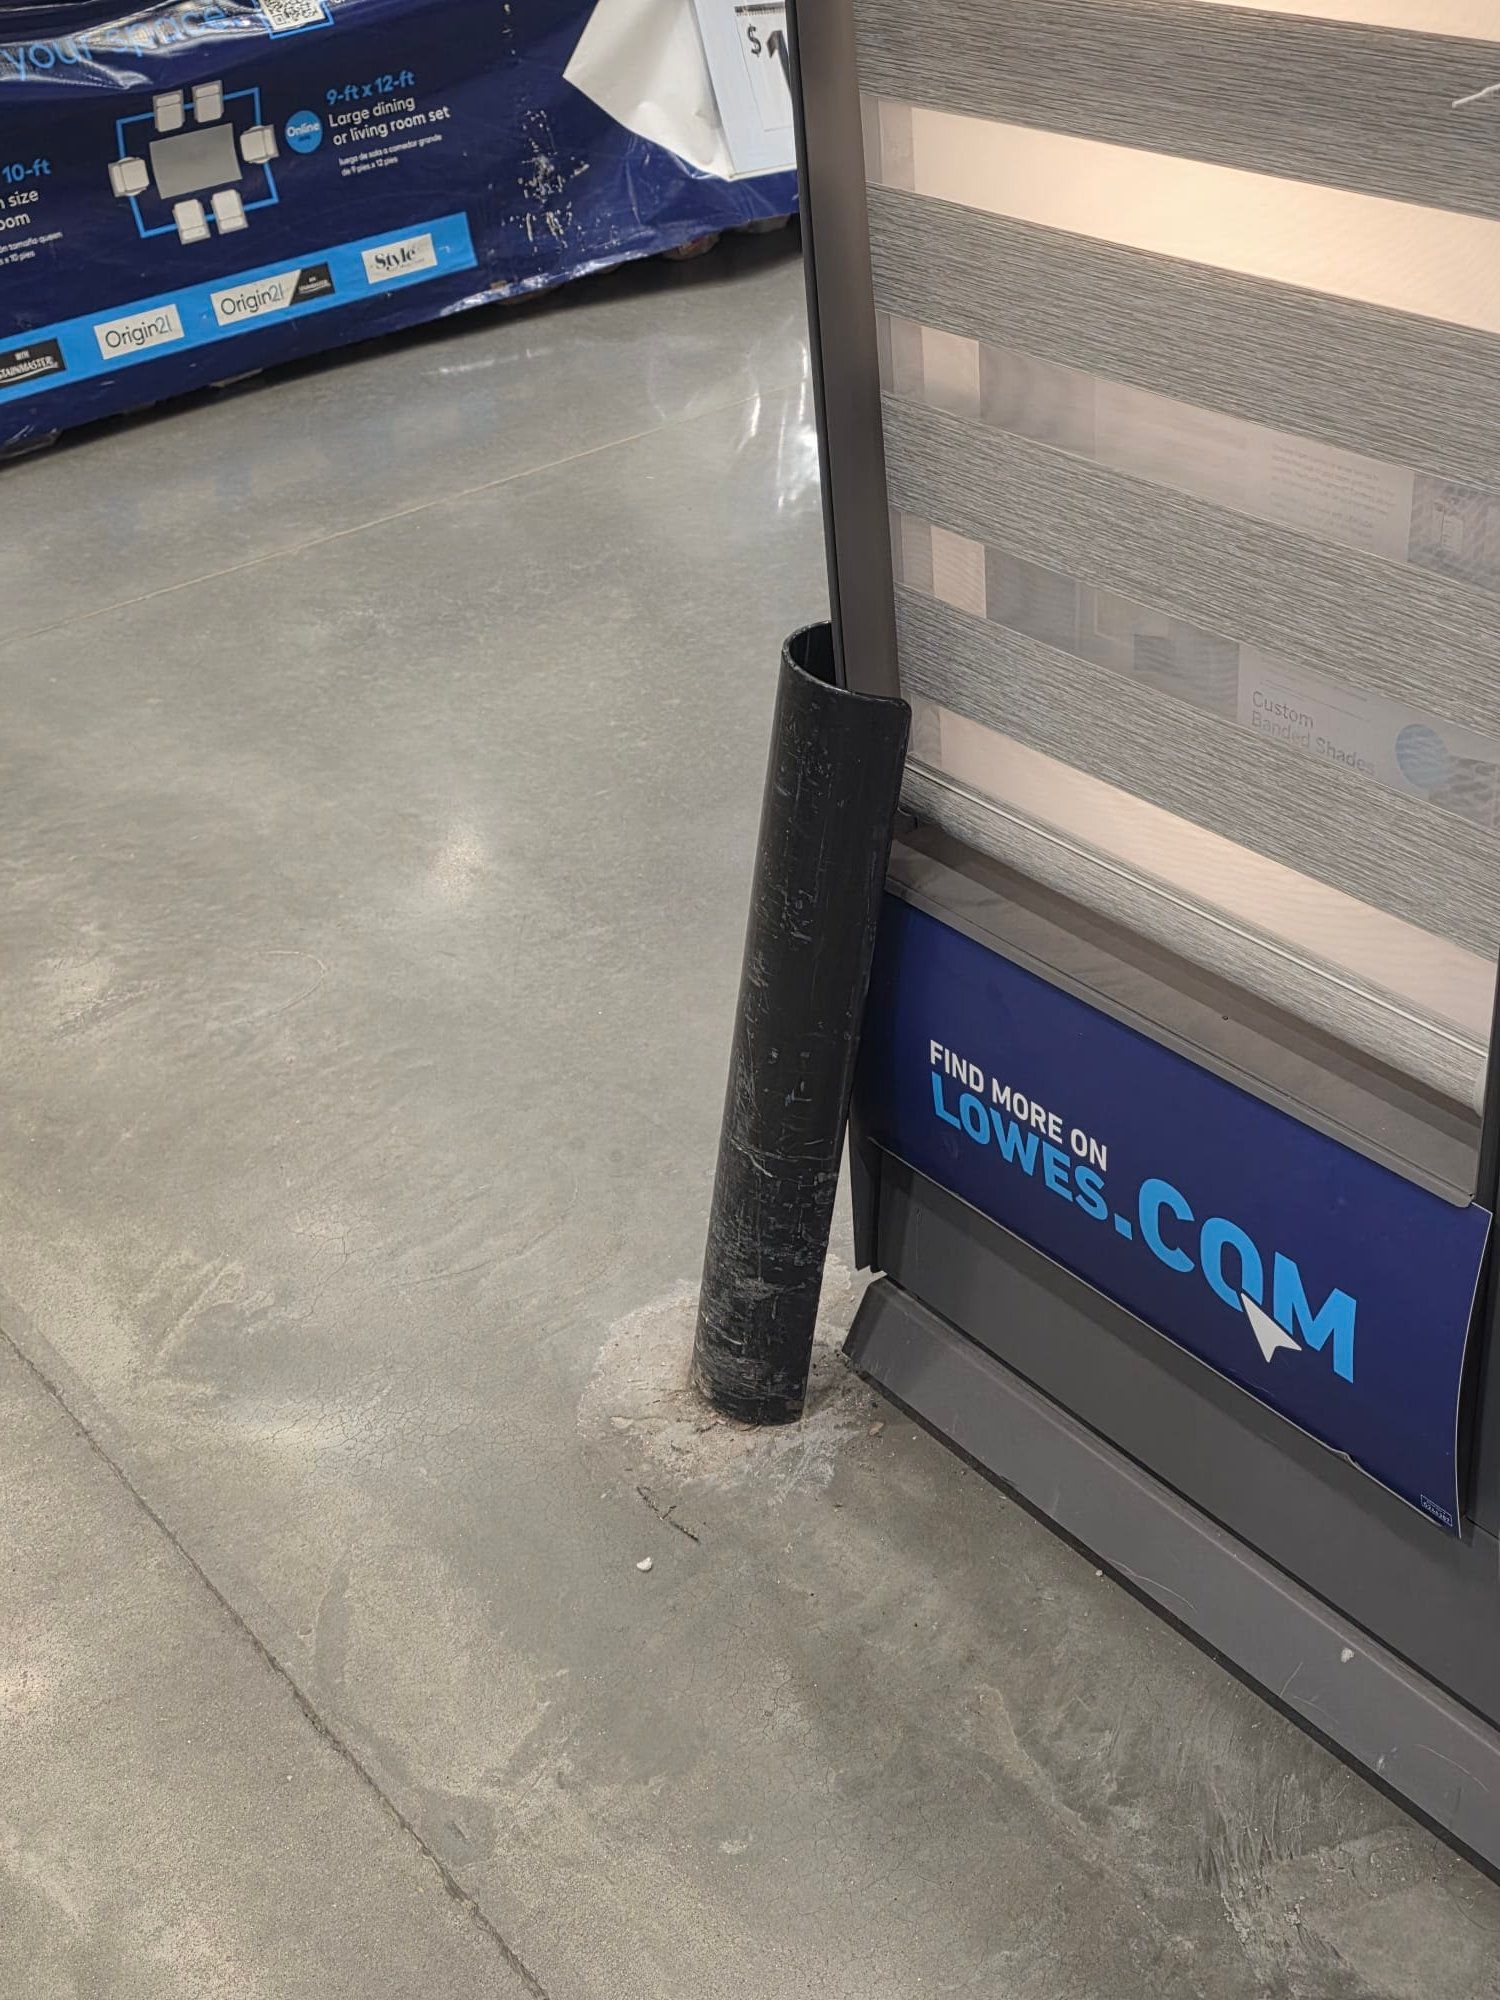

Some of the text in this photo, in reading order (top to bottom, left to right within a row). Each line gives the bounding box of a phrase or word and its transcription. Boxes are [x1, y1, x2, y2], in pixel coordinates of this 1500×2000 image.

[2, 6, 226, 81] your space
[326, 70, 415, 106] 9-ft x 12-ft
[328, 97, 415, 128] Large dining
[333, 106, 451, 146] or living room set
[286, 123, 321, 137] Online
[2, 158, 51, 184] 10-ft
[8, 190, 39, 207] size
[374, 247, 416, 271] Style
[220, 283, 284, 316] Origin21
[105, 314, 173, 348] Origin21
[1252, 690, 1314, 728] Custom
[1251, 711, 1376, 777] Banded Shades
[930, 1039, 1108, 1171] FIND MORE ON
